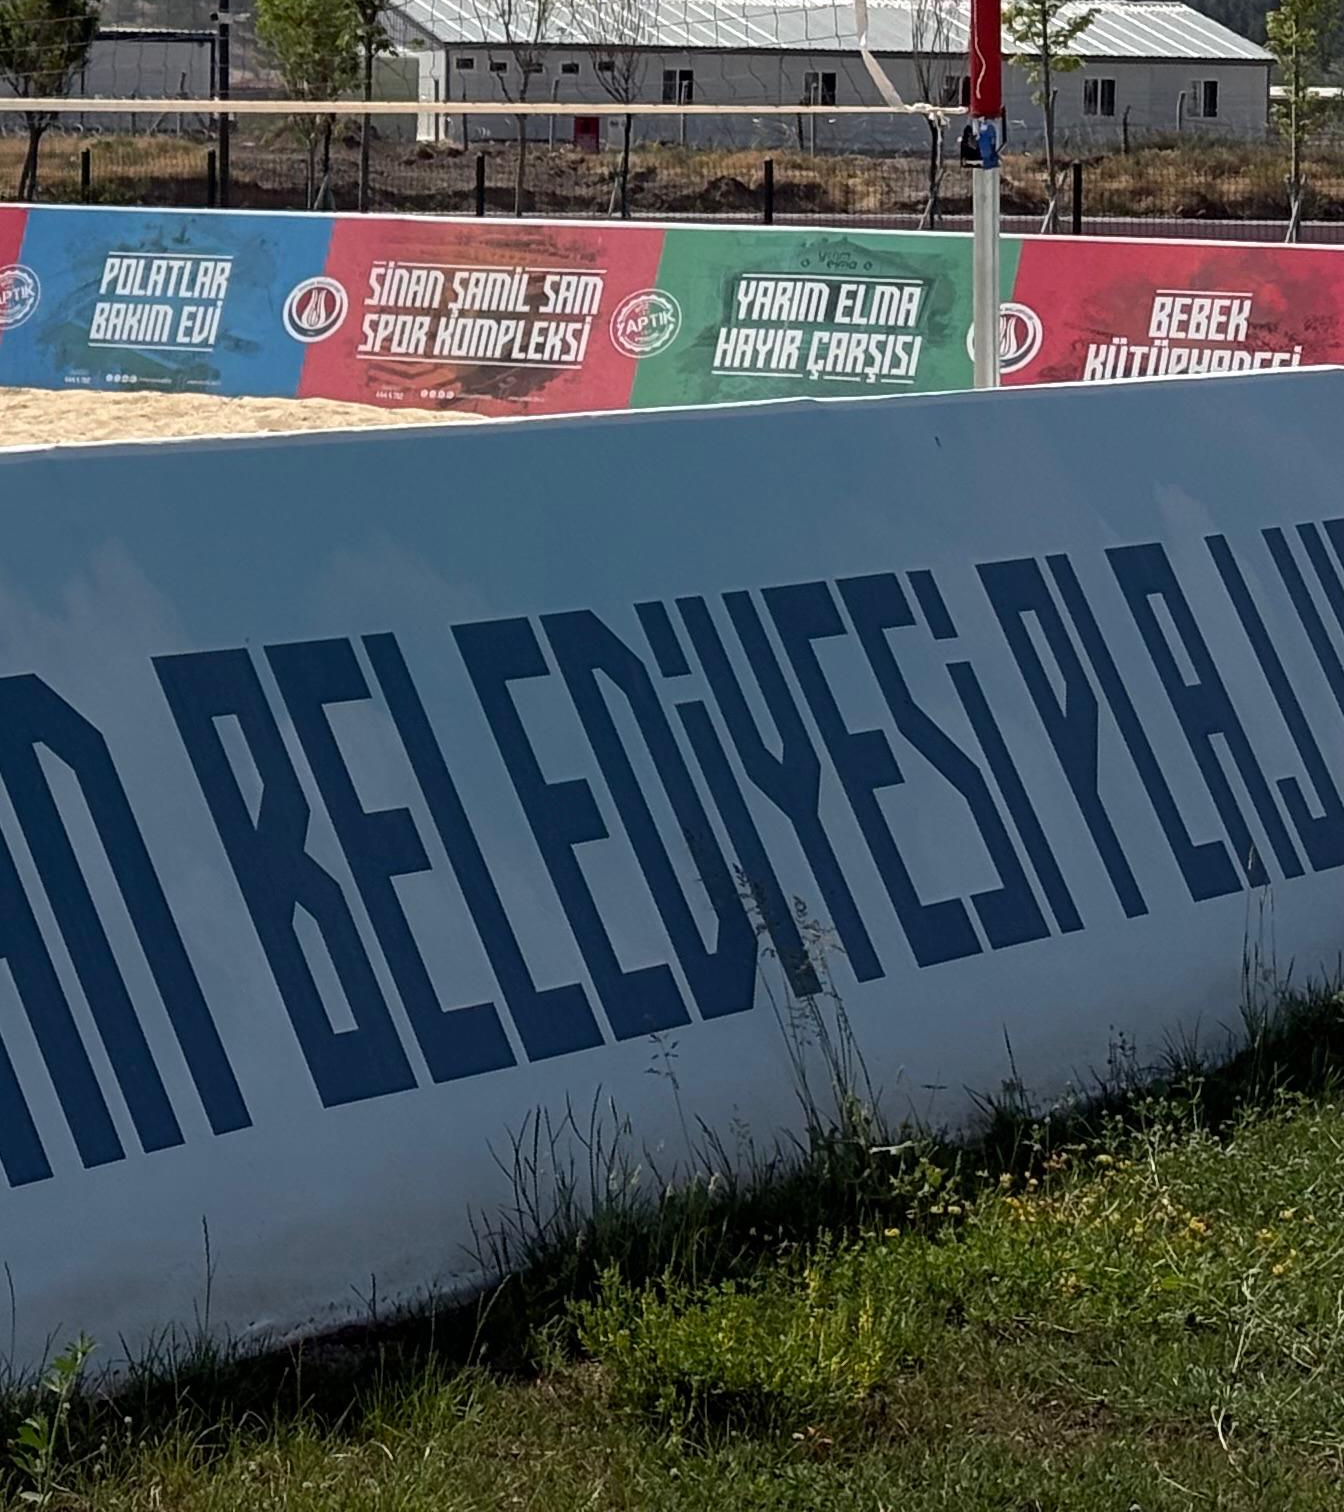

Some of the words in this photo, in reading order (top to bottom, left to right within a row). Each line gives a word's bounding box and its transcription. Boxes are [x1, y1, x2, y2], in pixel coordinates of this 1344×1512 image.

[99, 257, 232, 300] POLATLAR
[364, 261, 445, 309] SİNAN
[448, 266, 531, 318] ŞAMİL
[539, 274, 604, 316] SAM
[737, 279, 831, 323] YARIM
[834, 283, 922, 327] ELMA
[89, 301, 174, 343] BAKIM
[176, 300, 224, 345] EVİ
[358, 313, 431, 354] SPOR
[433, 315, 592, 363] KOMPLEKSİ
[1148, 295, 1253, 343] BEBEK
[713, 327, 804, 370] HAYIR
[806, 330, 923, 384] ÇARŞISI
[150, 568, 1085, 1108] BELEDİYESİ
